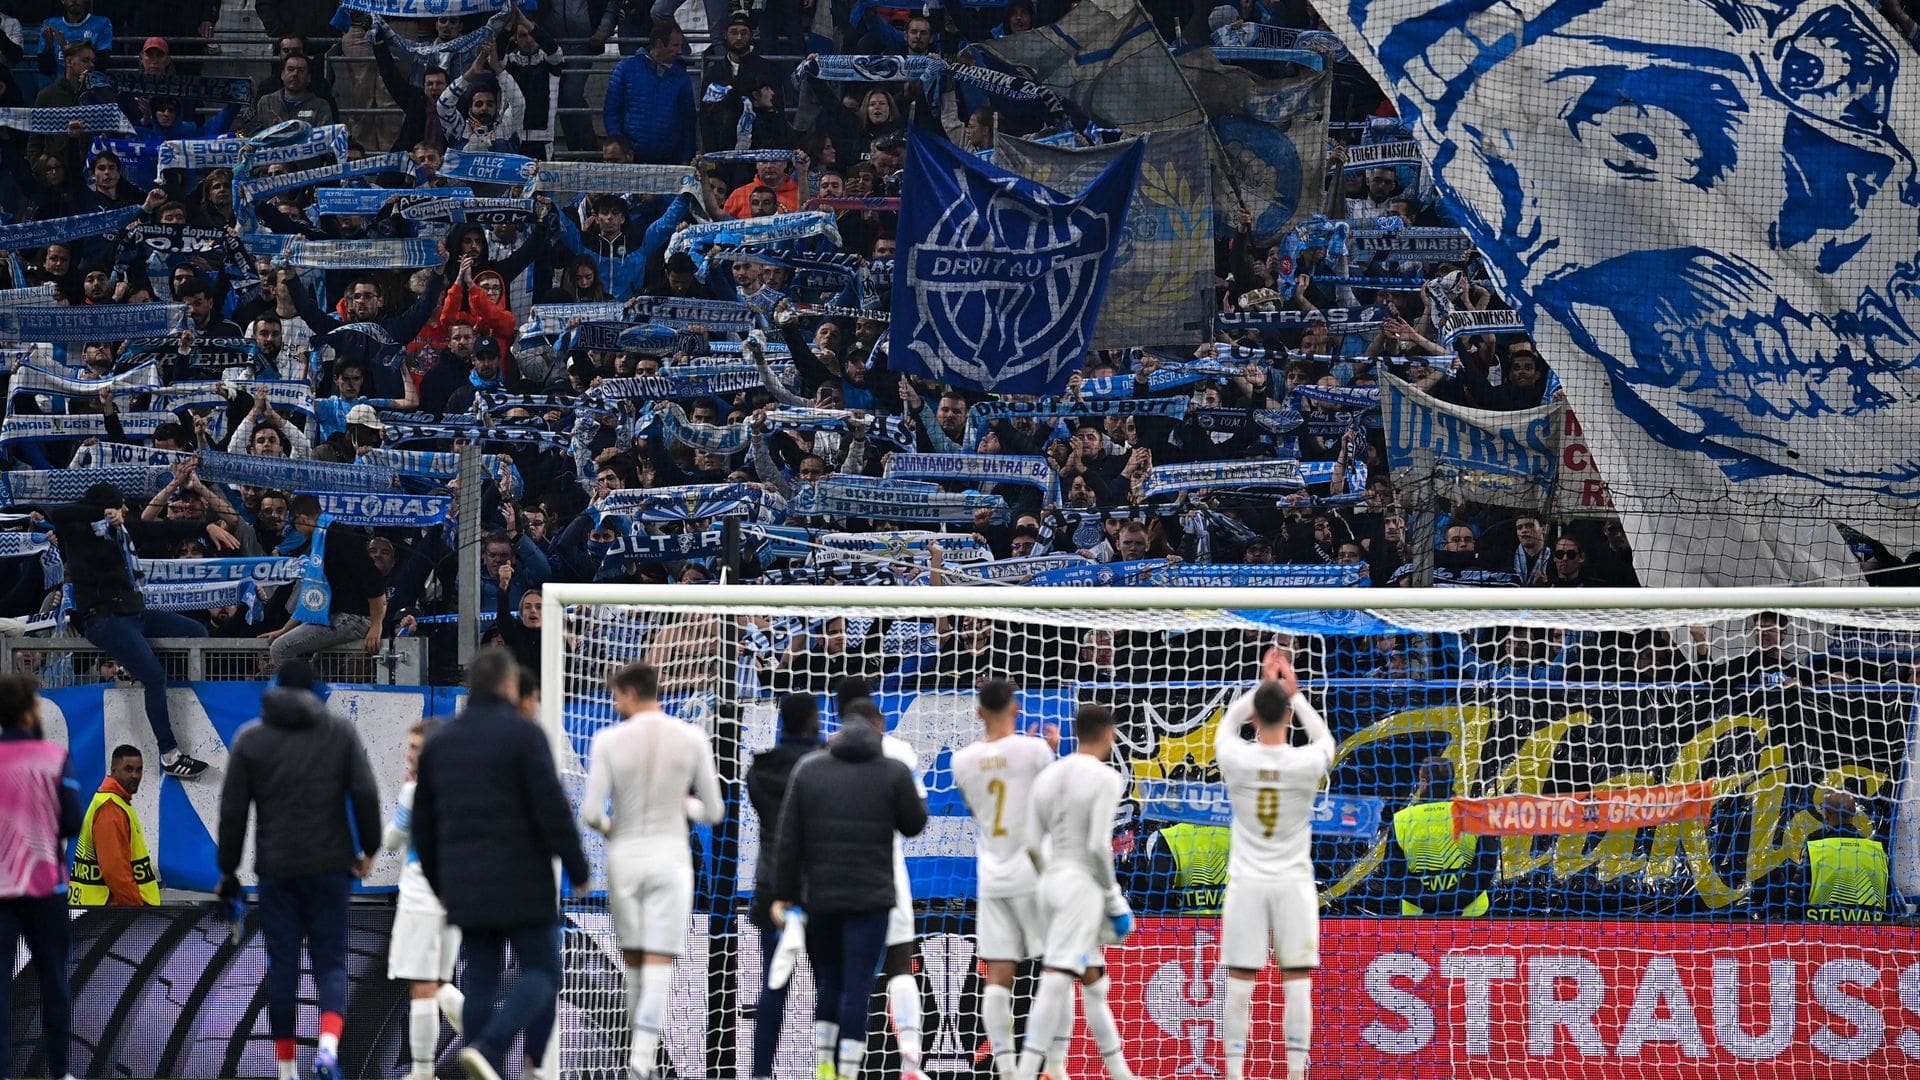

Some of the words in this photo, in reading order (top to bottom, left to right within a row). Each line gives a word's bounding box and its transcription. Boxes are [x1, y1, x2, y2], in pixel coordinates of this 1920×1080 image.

[1381, 143, 1422, 159] MASSILIEN
[1363, 238, 1410, 251] ALLEZ
[931, 256, 1006, 276] DROIT
[1009, 258, 1042, 277] AU
[1219, 307, 1349, 325] ULTRAS
[115, 351, 254, 370] MAREILLE
[602, 377, 676, 398] OLYMPIQUE
[706, 371, 763, 392] MARSEIL
[977, 401, 1059, 417] DROIT
[1070, 400, 1109, 413] AU
[1117, 398, 1177, 413] BUT
[63, 419, 90, 429] LES
[1389, 381, 1557, 478] ULTRAS
[430, 451, 461, 475] AU
[889, 455, 963, 472] COMMANDO
[1031, 461, 1049, 478] 84
[942, 551, 985, 562] arseille
[148, 560, 223, 582] ALLEZ
[987, 779, 1007, 837] 2
[1256, 787, 1281, 839] 9
[1487, 800, 1574, 829] KAOTIC
[1607, 791, 1685, 824] GROUP
[1806, 908, 1884, 922] STEWAR
